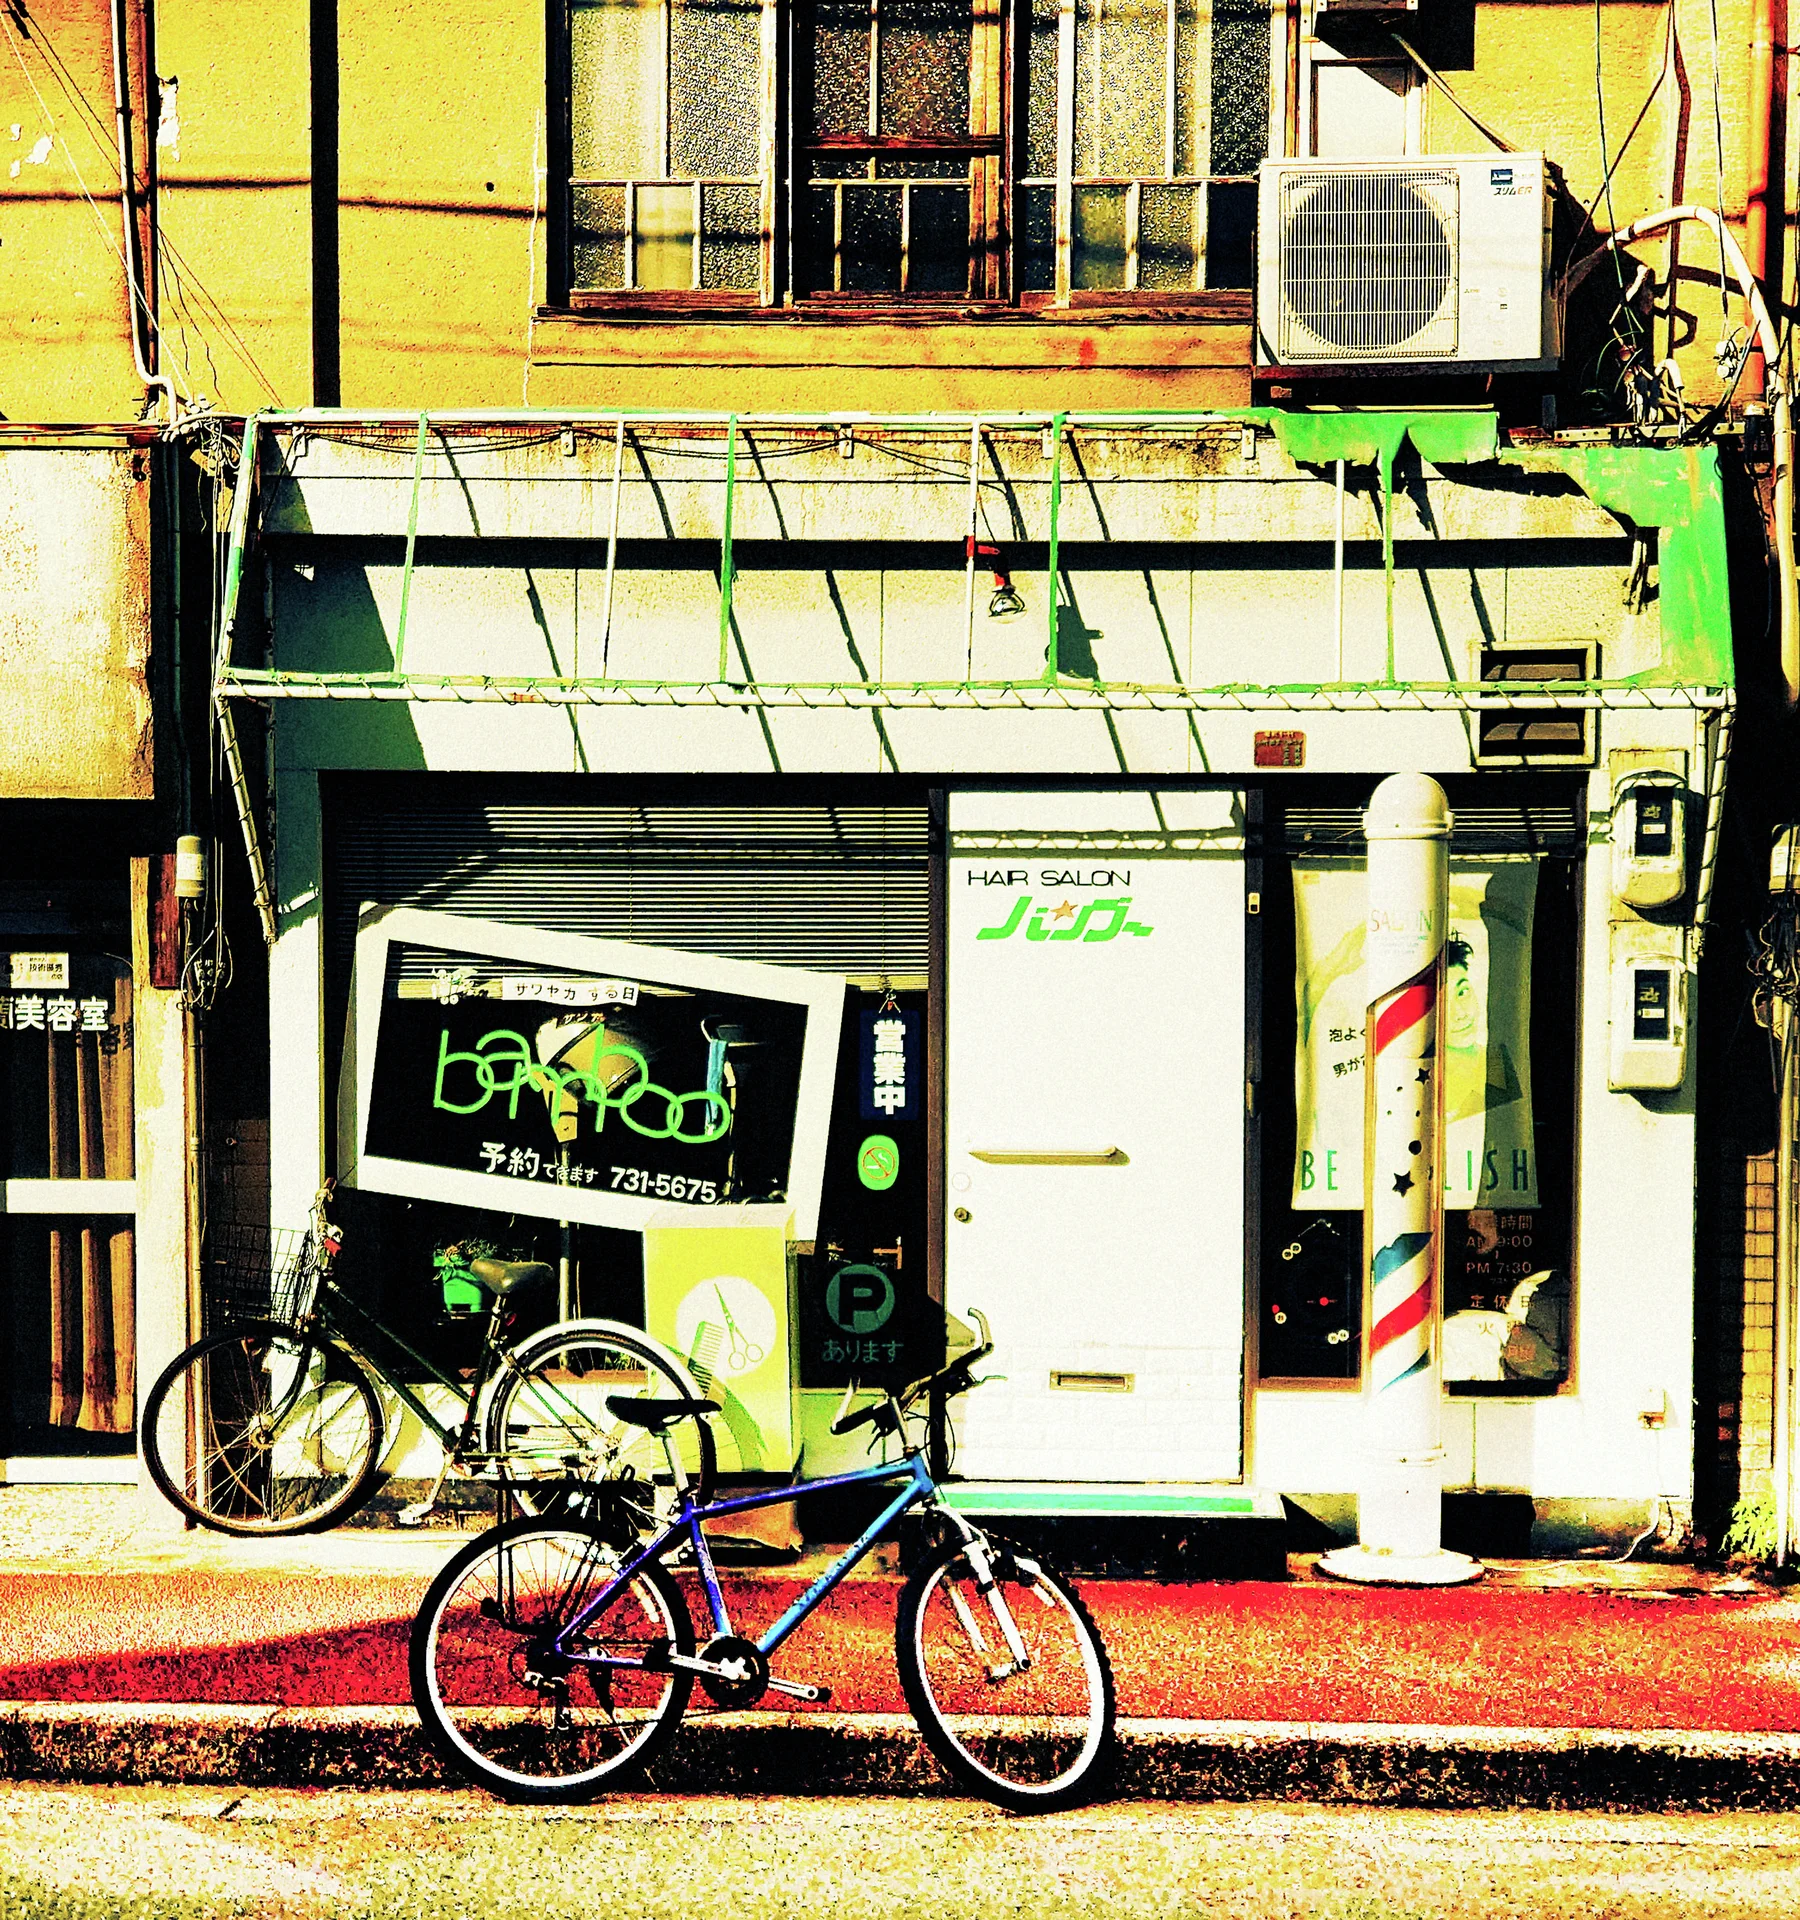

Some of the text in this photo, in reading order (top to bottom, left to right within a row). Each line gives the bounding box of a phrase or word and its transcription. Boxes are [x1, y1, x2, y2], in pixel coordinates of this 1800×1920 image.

[969, 870, 1131, 887] HAIR SALON
[1370, 909, 1433, 932] SALN
[434, 1023, 730, 1144] bamboo
[873, 1019, 906, 1115] 営業中
[479, 1141, 717, 1203] 予約できます 731-5675
[1301, 1150, 1339, 1191] BE
[1465, 1261, 1533, 1275] PM 7:30
[822, 1340, 904, 1366] あります
